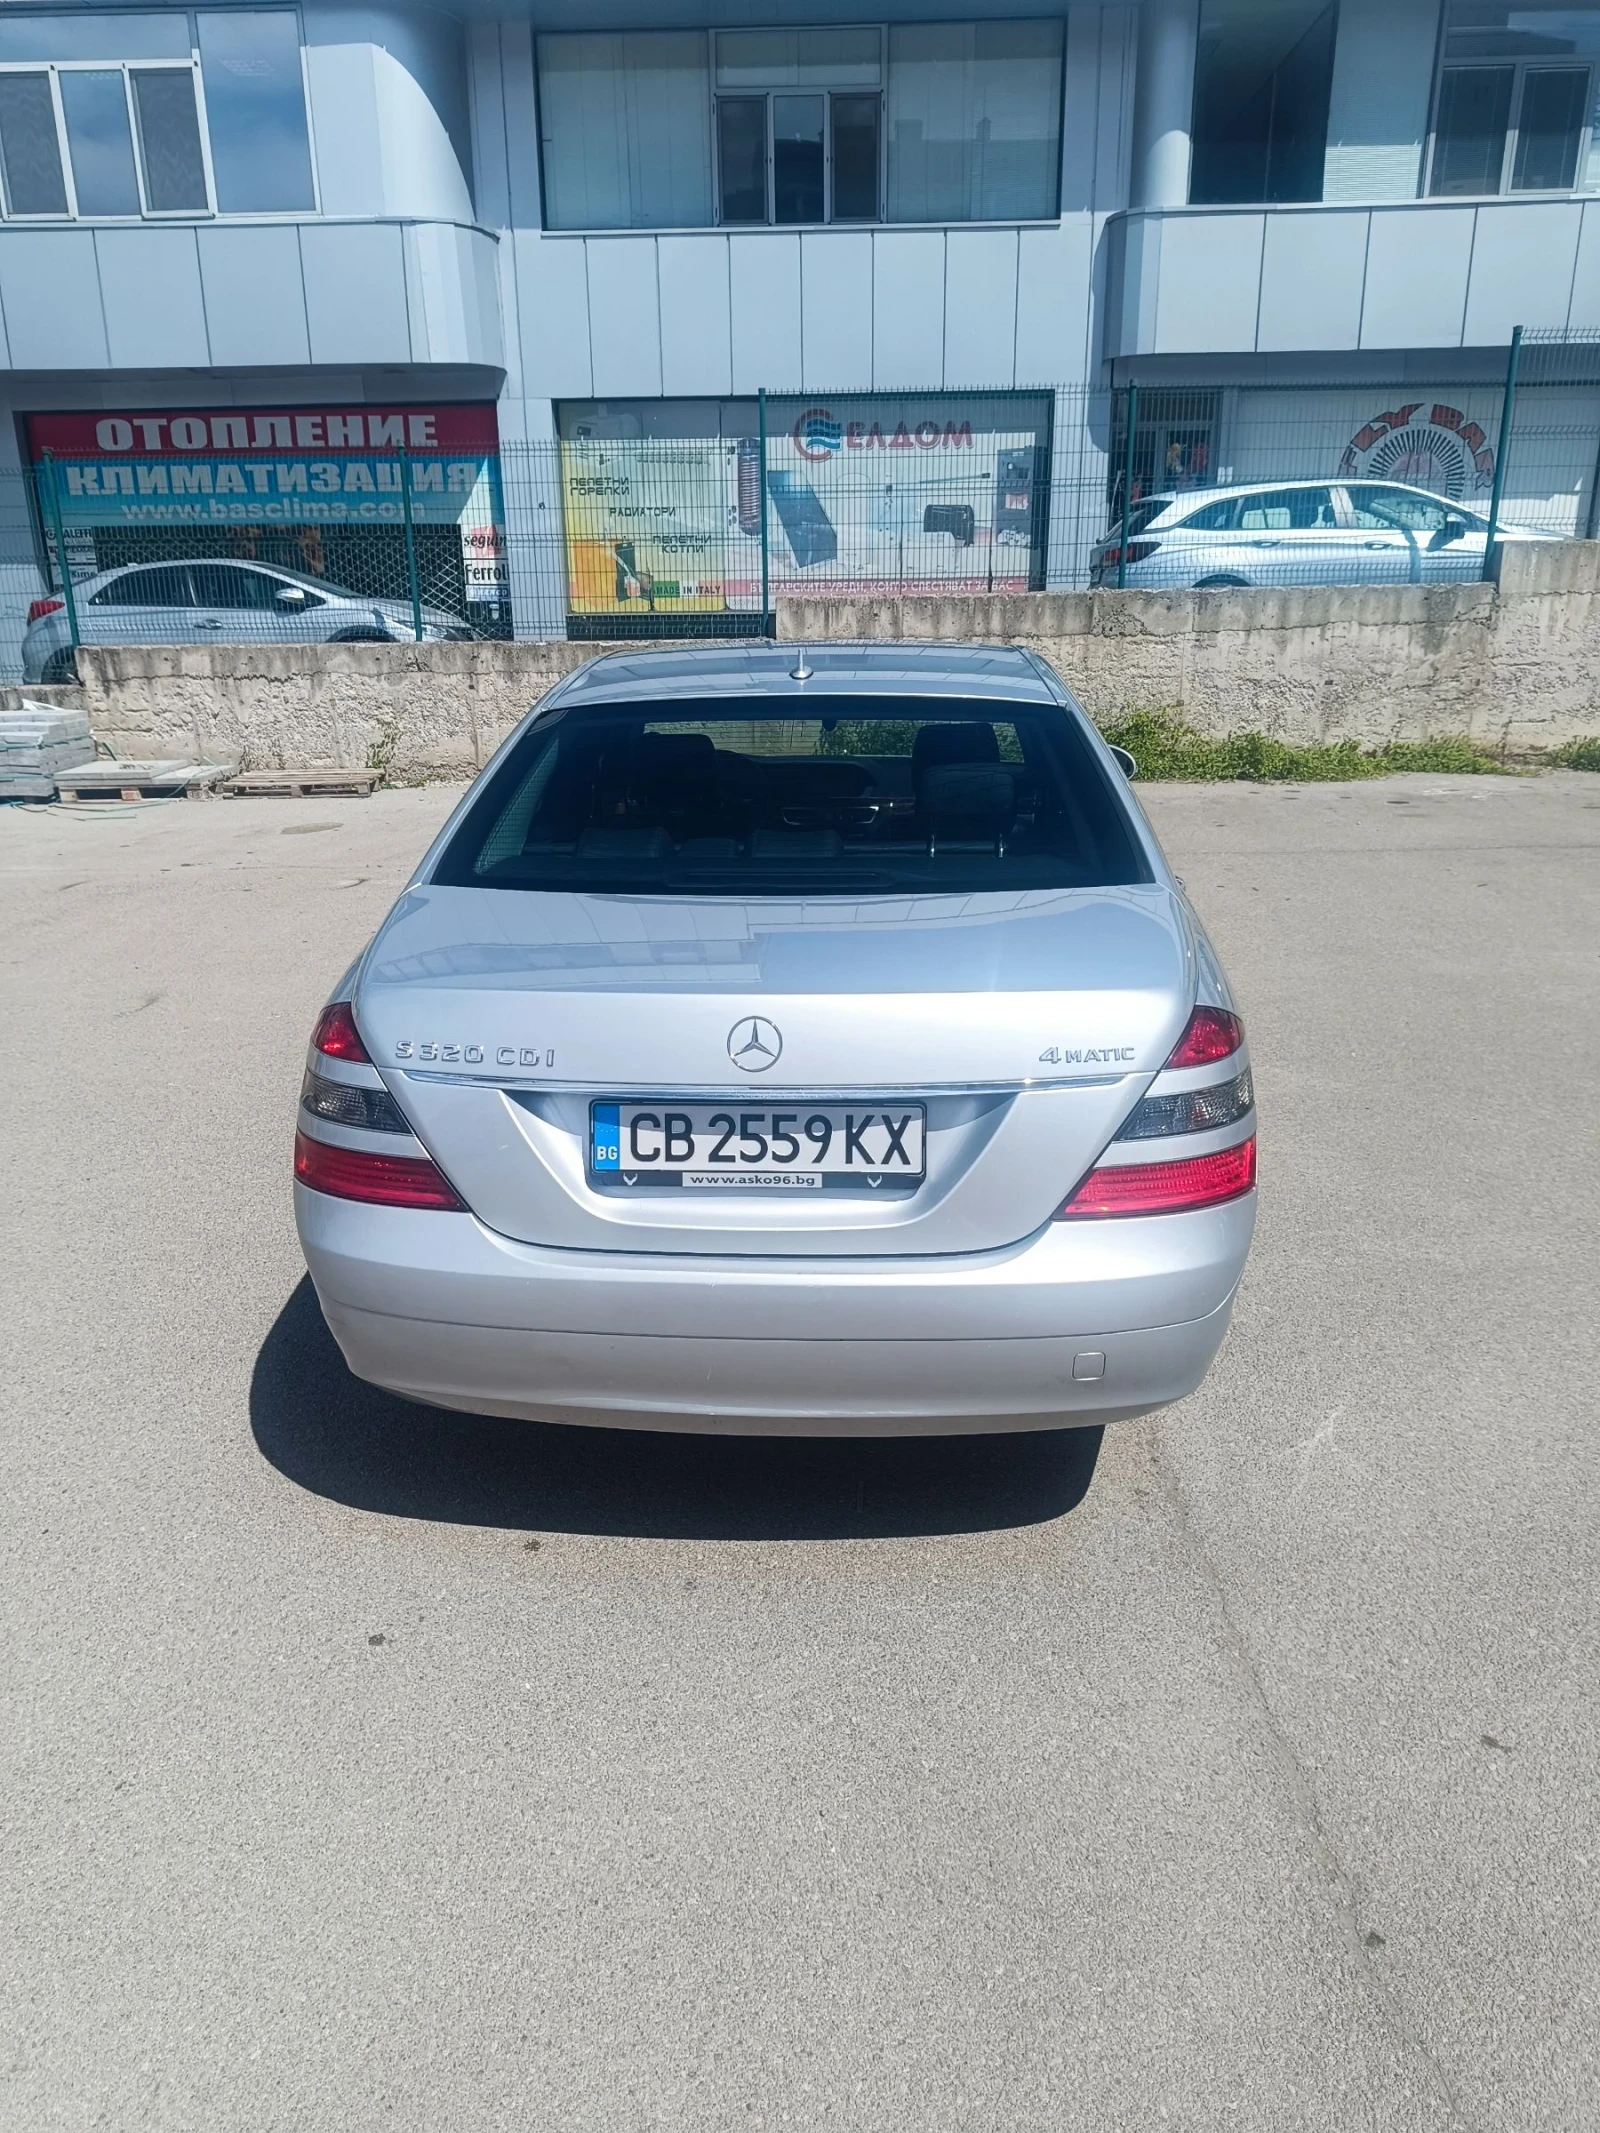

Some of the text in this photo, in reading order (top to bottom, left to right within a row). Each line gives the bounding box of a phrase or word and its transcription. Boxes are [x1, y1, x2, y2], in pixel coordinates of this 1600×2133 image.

[96, 415, 438, 450] ОТОПЛЕНИЕ
[846, 420, 973, 449] ЕЛДОМ
[1429, 403, 1495, 491] BAR
[66, 462, 477, 495] КЛИМАТИЗАЦИЯ
[121, 498, 426, 520] www.basclima.com
[655, 584, 720, 595] MADE IN ITALY
[496, 1047, 555, 1067] CDI
[630, 1112, 912, 1165] CB 2559 KX
[597, 1146, 618, 1160] BG
[690, 1175, 815, 1187] www.asko96.bg
